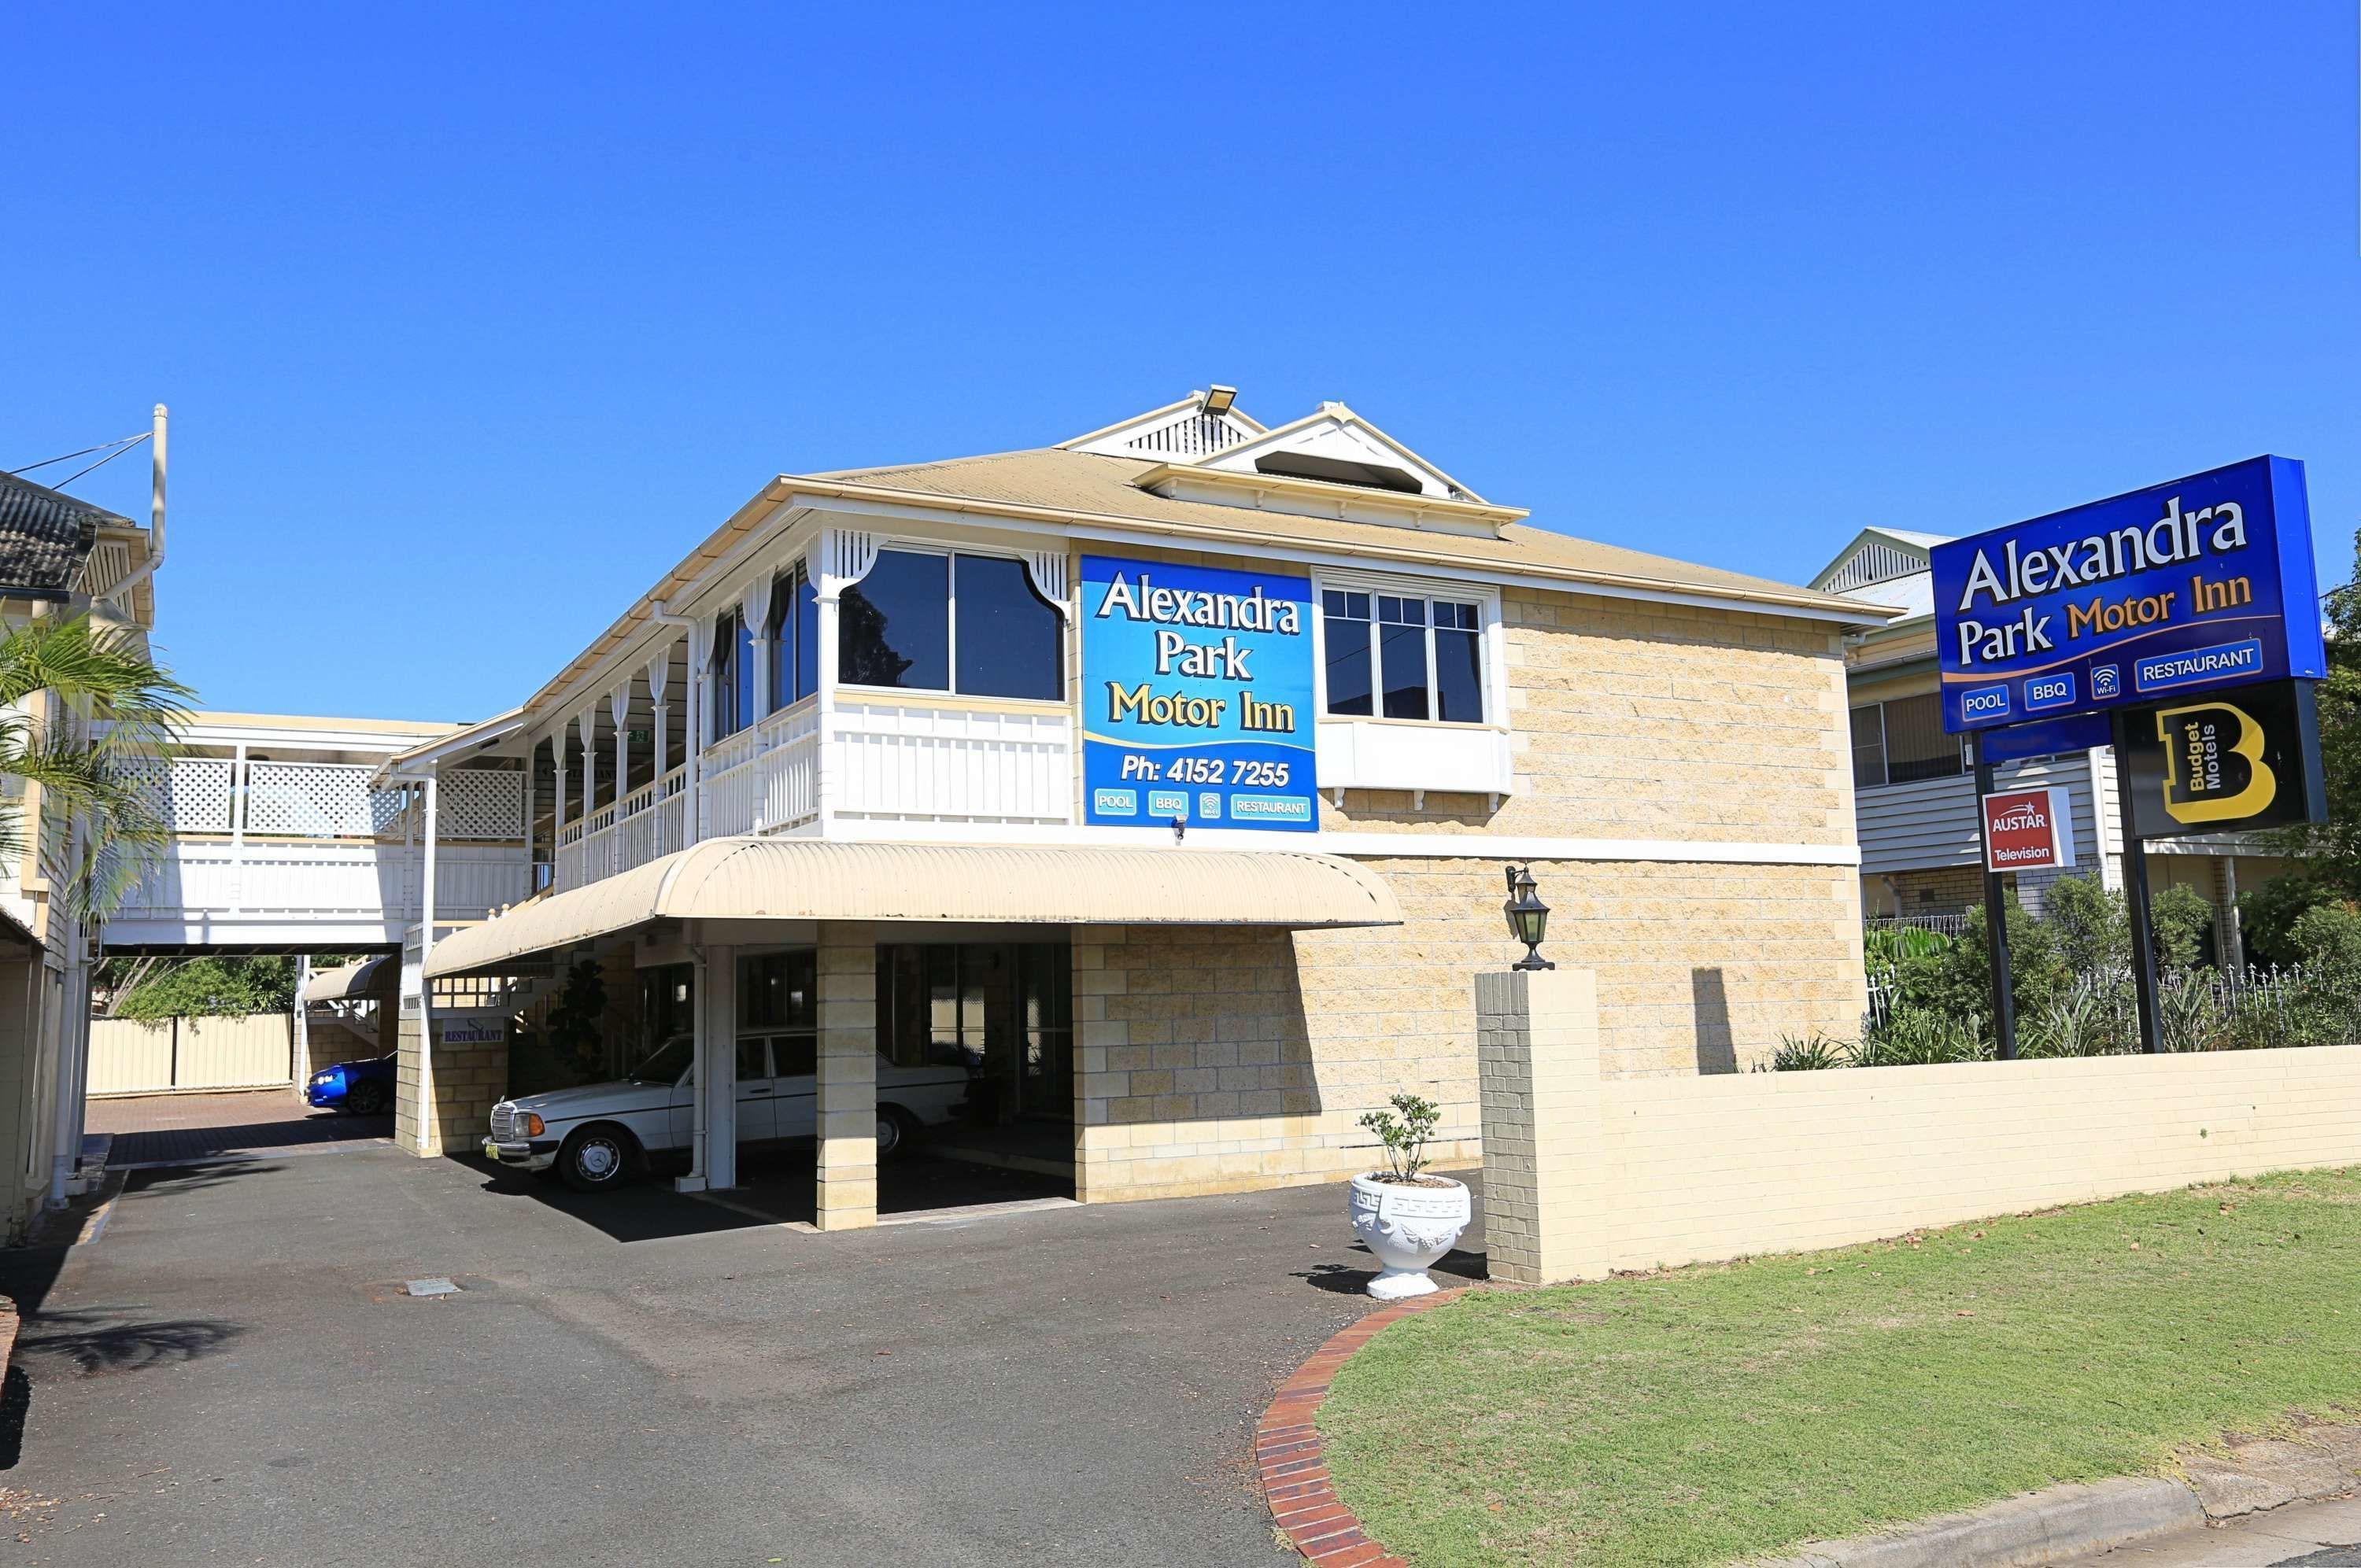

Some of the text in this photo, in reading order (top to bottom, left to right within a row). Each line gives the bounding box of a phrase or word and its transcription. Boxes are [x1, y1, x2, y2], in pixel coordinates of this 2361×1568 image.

[1959, 496, 2248, 612] Alexandra
[1096, 570, 1300, 635] Alexandra
[1958, 575, 2252, 665] Park Motor Inn
[1155, 630, 1253, 681] Park
[2143, 648, 2254, 681] RESTAURANT
[1966, 693, 2006, 712] POOL
[2033, 682, 2067, 700] BBQ
[2097, 685, 2117, 695] Wi-Fi
[1105, 681, 1295, 732] Motor Inn
[2184, 721, 2204, 791] Budget
[2202, 724, 2221, 790] Motels
[1121, 754, 1290, 788] Ph: 4152 7255
[1099, 795, 1134, 809] POOL
[1155, 797, 1183, 810] BBQ
[1236, 801, 1306, 815] RESTAURANT
[1993, 814, 2045, 832] AUSTAR
[1994, 847, 2049, 861] Television
[445, 1030, 502, 1042] RESTAURANT
